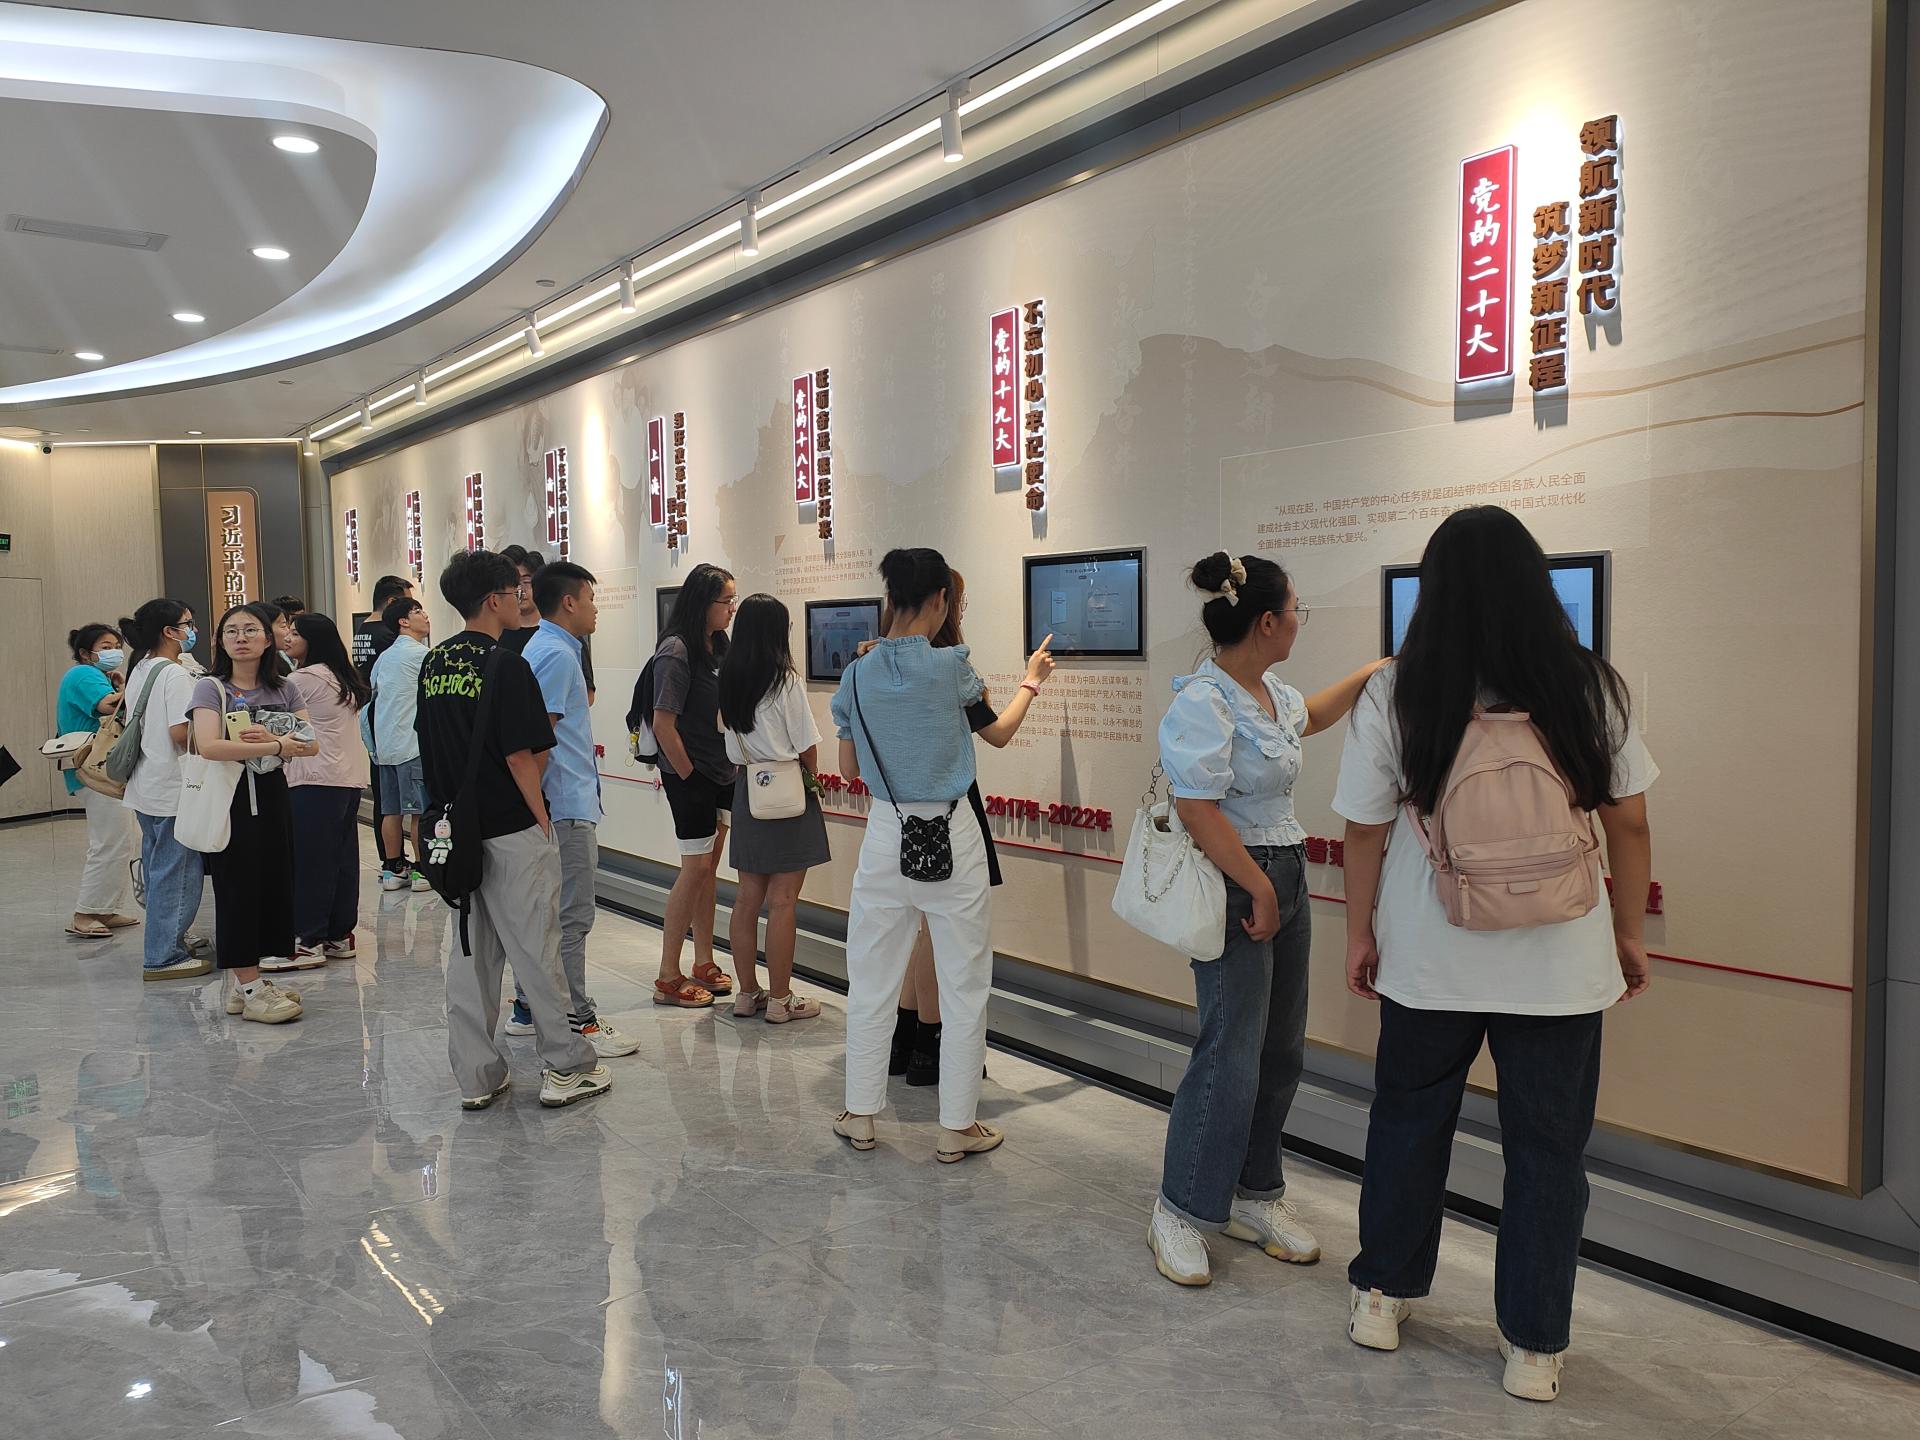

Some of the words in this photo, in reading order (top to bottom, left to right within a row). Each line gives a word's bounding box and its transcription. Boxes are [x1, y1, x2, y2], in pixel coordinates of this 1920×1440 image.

[1466, 177, 1500, 356] 党的二十大
[1529, 201, 1569, 391] 筑梦新征程
[1577, 114, 1618, 315] 领航新时代
[795, 389, 808, 489] 党的十八大
[994, 327, 1012, 450] 党的十九大
